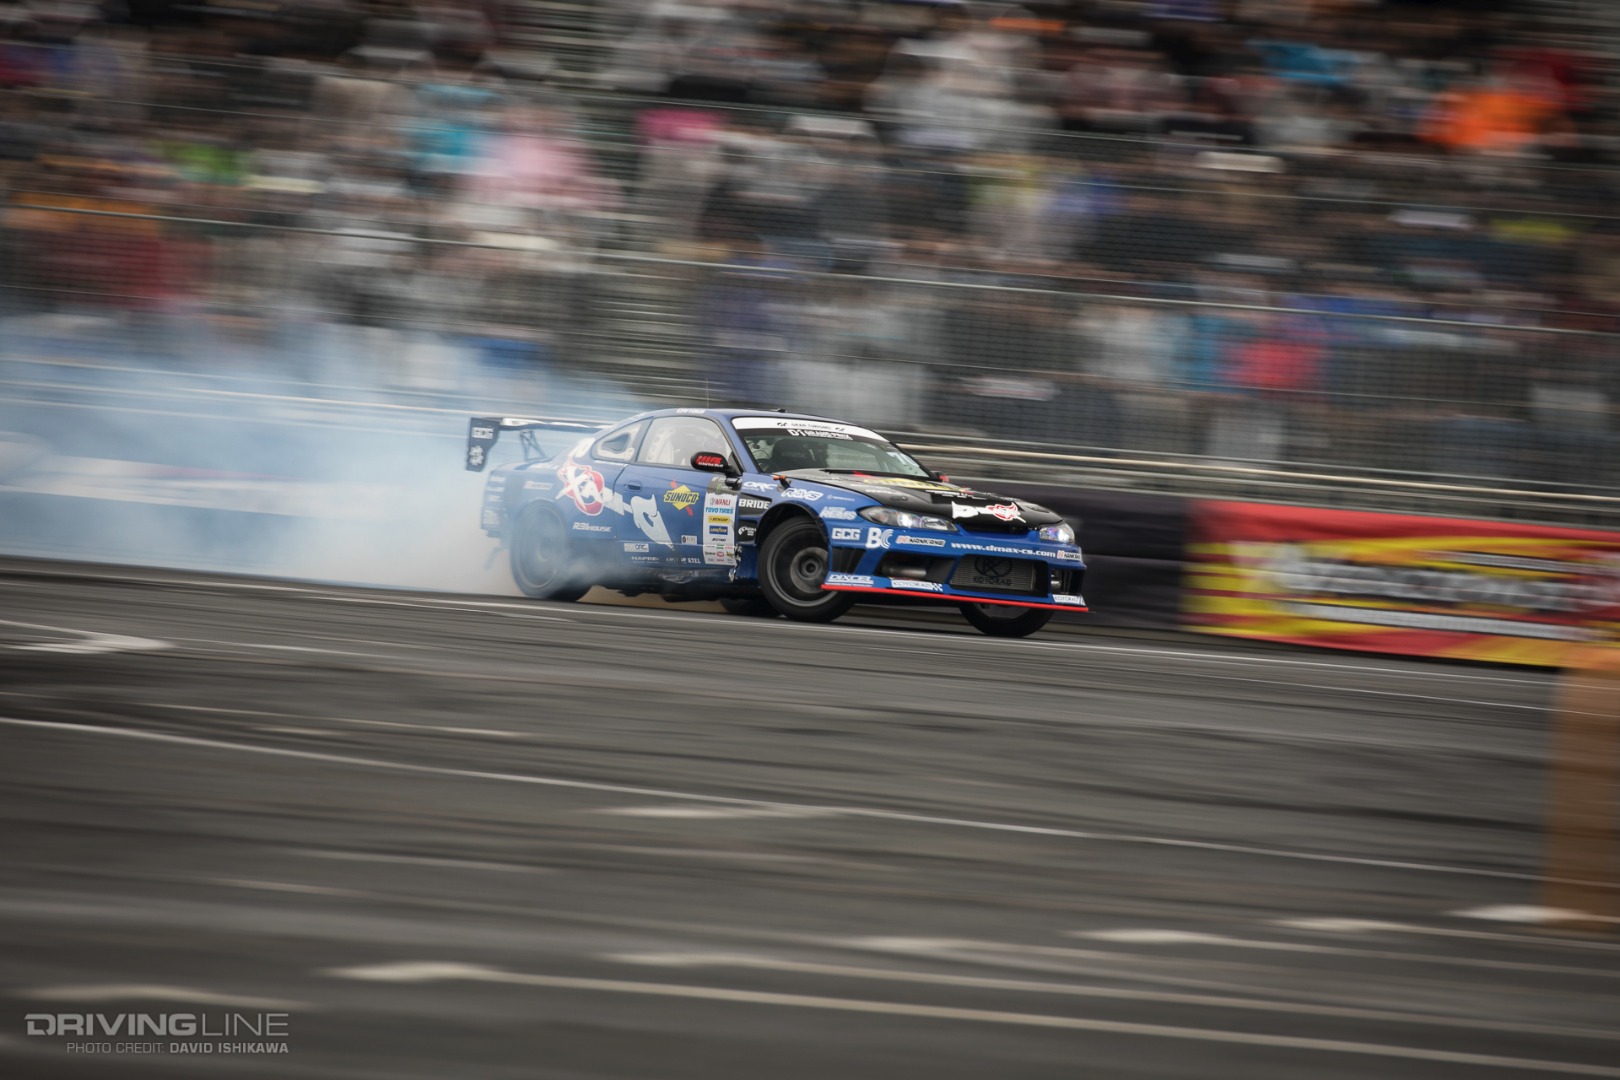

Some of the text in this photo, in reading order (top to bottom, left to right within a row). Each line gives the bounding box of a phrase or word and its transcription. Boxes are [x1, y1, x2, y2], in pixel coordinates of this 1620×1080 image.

[664, 492, 698, 504] SUNOCO
[739, 499, 770, 510] BRIDE
[832, 528, 861, 540] GCG
[909, 538, 945, 547] NANKANG
[951, 542, 1056, 558] www.dmax-cs.com
